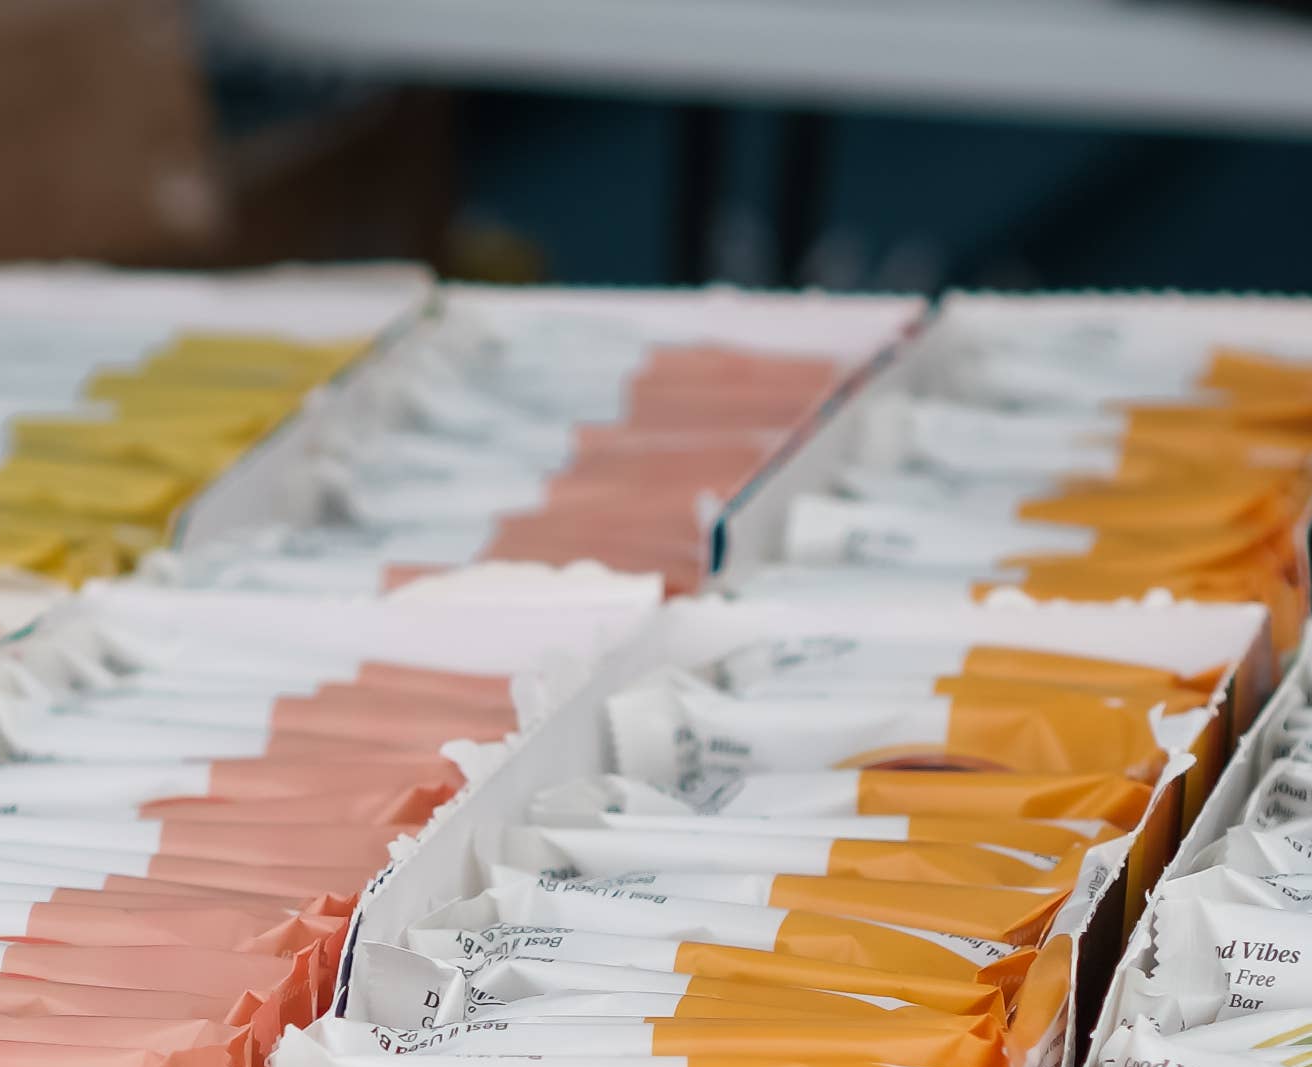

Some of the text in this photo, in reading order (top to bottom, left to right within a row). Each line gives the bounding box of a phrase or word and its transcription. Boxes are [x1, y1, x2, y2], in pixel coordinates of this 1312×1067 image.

[1242, 941, 1301, 964] Vibes
[1235, 969, 1276, 989] Free
[1229, 993, 1264, 1012] Bar
